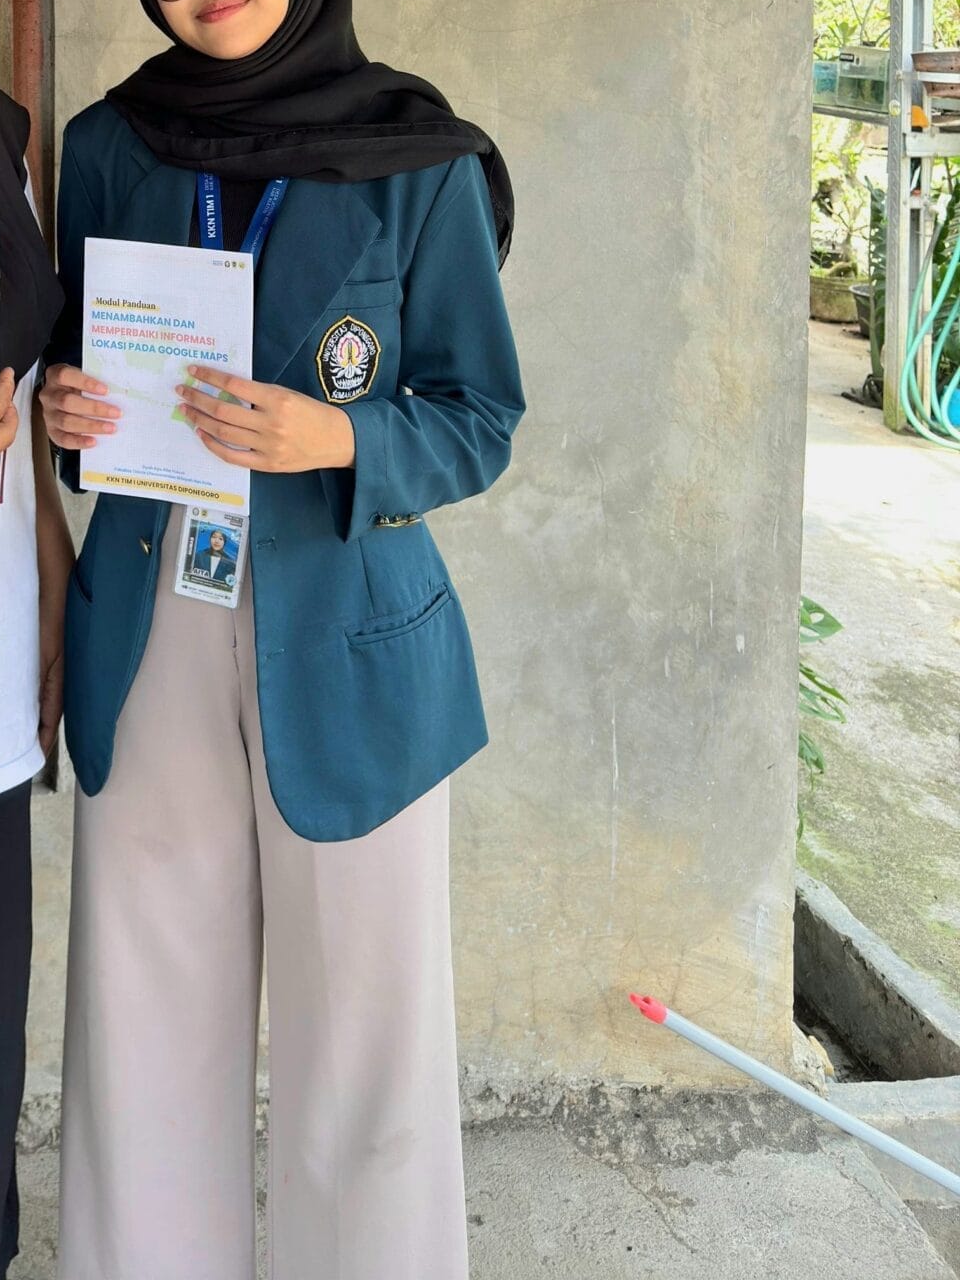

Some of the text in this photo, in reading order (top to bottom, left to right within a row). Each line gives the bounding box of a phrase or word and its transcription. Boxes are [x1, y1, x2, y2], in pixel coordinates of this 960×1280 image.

[206, 199, 215, 217] TIM
[207, 218, 216, 239] KKN
[95, 297, 156, 310] Modul Panduan
[91, 310, 195, 329] MENAMBAHKAN DAN
[91, 325, 215, 346] MEMPERBAIKI INFORMASI
[91, 339, 229, 363] LOKASI PADA GOOGLE MAPS
[136, 480, 178, 492] UNIVERSITAS
[178, 486, 220, 499] DIPONEGORO
